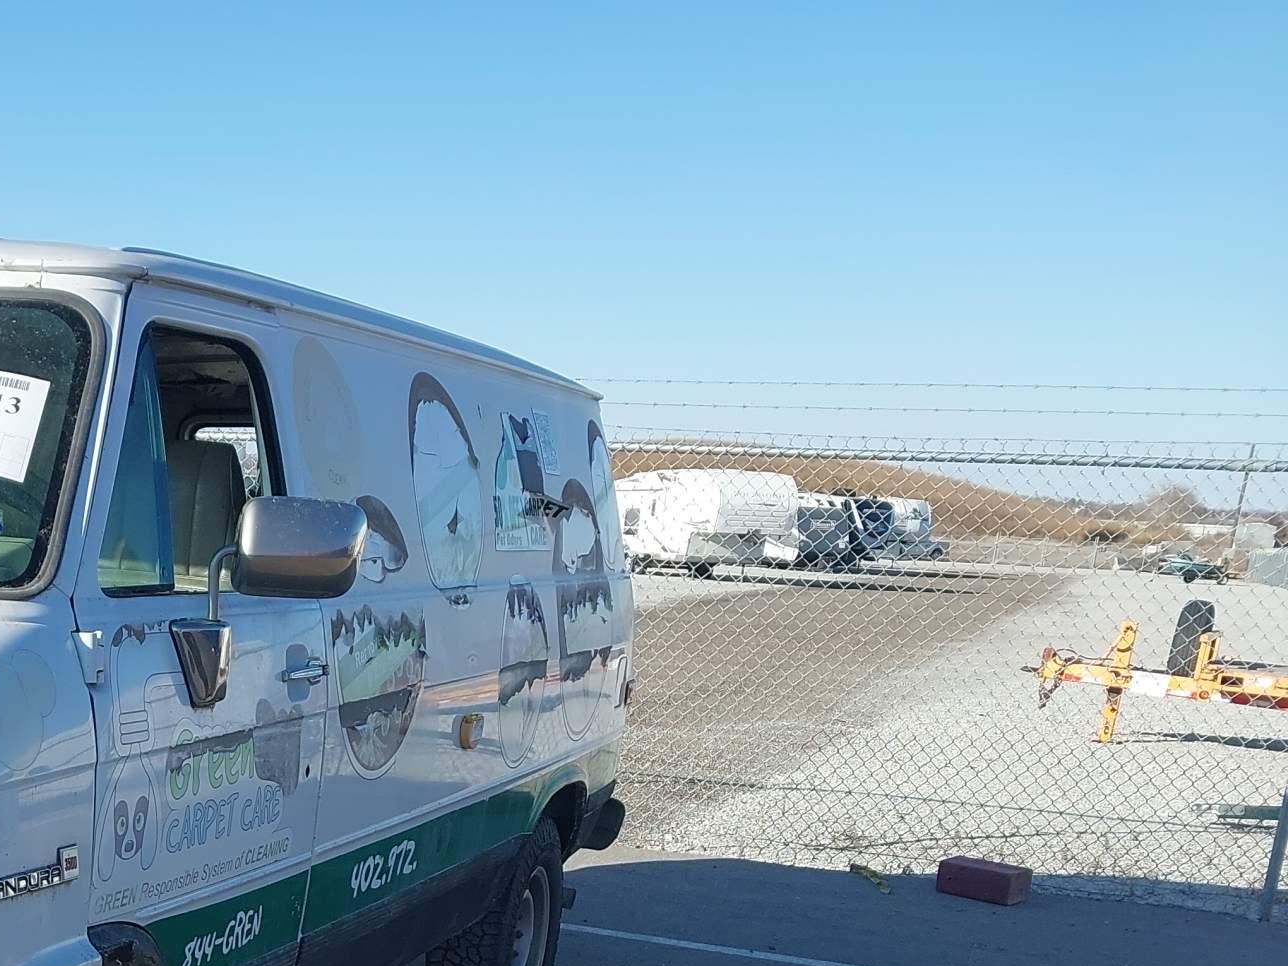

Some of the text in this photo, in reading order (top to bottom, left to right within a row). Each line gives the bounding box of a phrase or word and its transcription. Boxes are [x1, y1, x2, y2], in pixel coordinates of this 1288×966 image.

[166, 785, 282, 853] CARPET CARE
[95, 836, 290, 915] GREEN Responsible System of CLEANING
